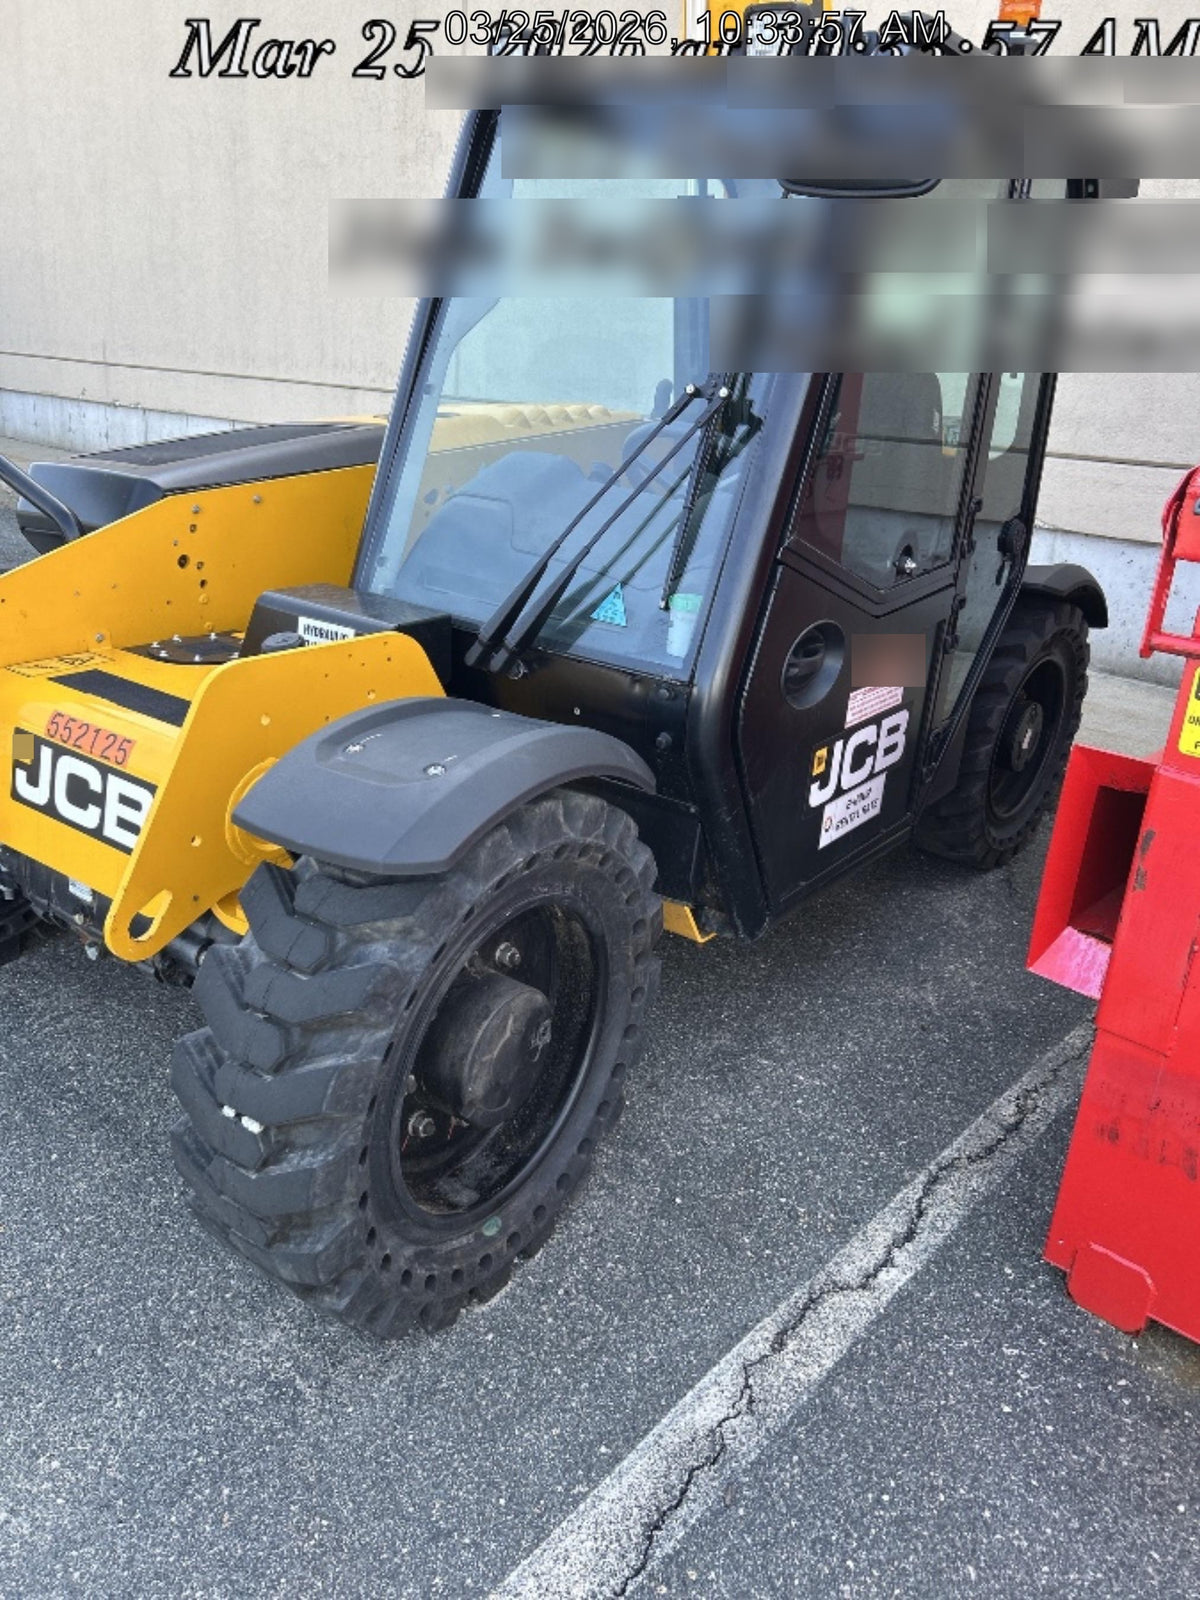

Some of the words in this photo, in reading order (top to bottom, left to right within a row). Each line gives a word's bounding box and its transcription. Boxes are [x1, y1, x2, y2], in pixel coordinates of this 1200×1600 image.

[47, 711, 132, 765] 552125
[808, 708, 910, 808] JCB
[15, 744, 155, 850] JCB
